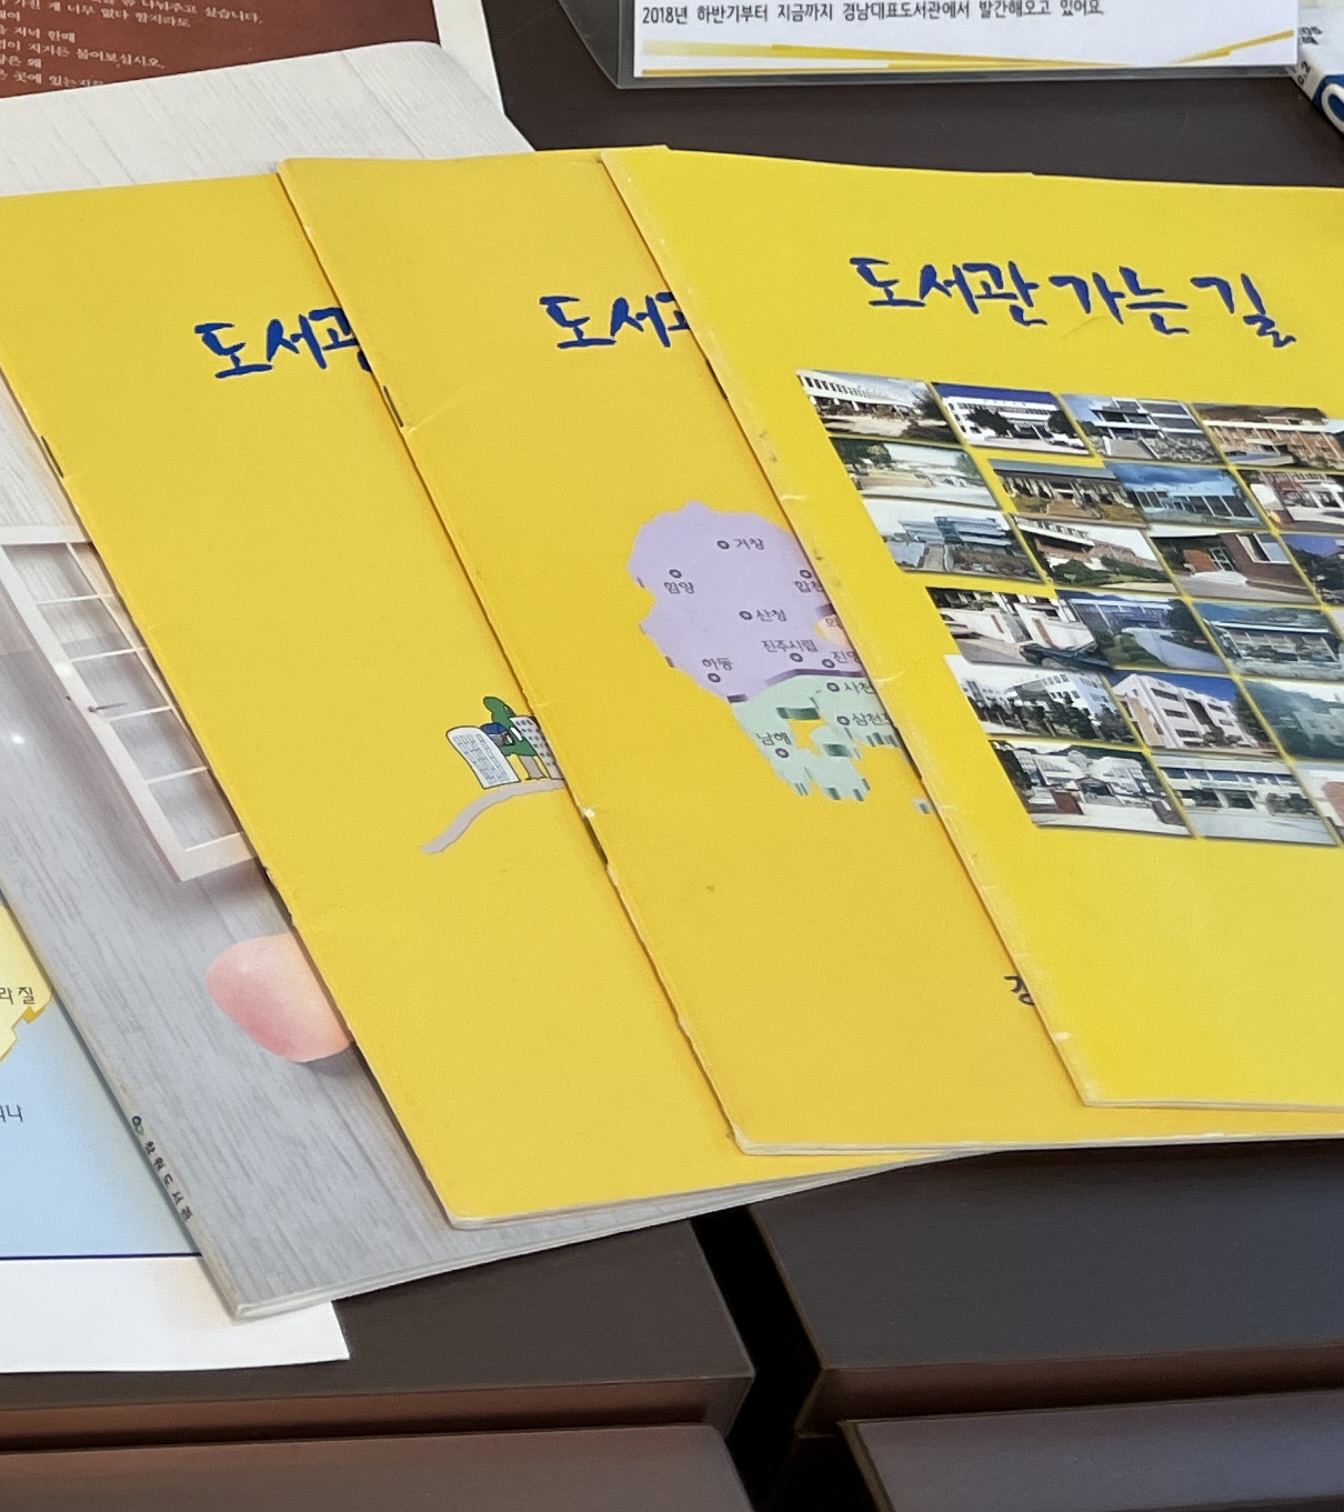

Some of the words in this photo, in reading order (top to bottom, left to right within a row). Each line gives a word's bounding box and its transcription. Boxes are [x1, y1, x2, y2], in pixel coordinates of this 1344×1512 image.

[643, 6, 687, 24] 2018년
[697, 5, 767, 24] 하반기부터
[778, 3, 832, 22] 지금까지
[843, 0, 969, 21] 경남대표도서관에서
[979, 0, 1051, 18] 발간해오고
[849, 255, 1045, 331] 도서관
[1054, 265, 1190, 337] 가는
[1193, 269, 1298, 347] 길
